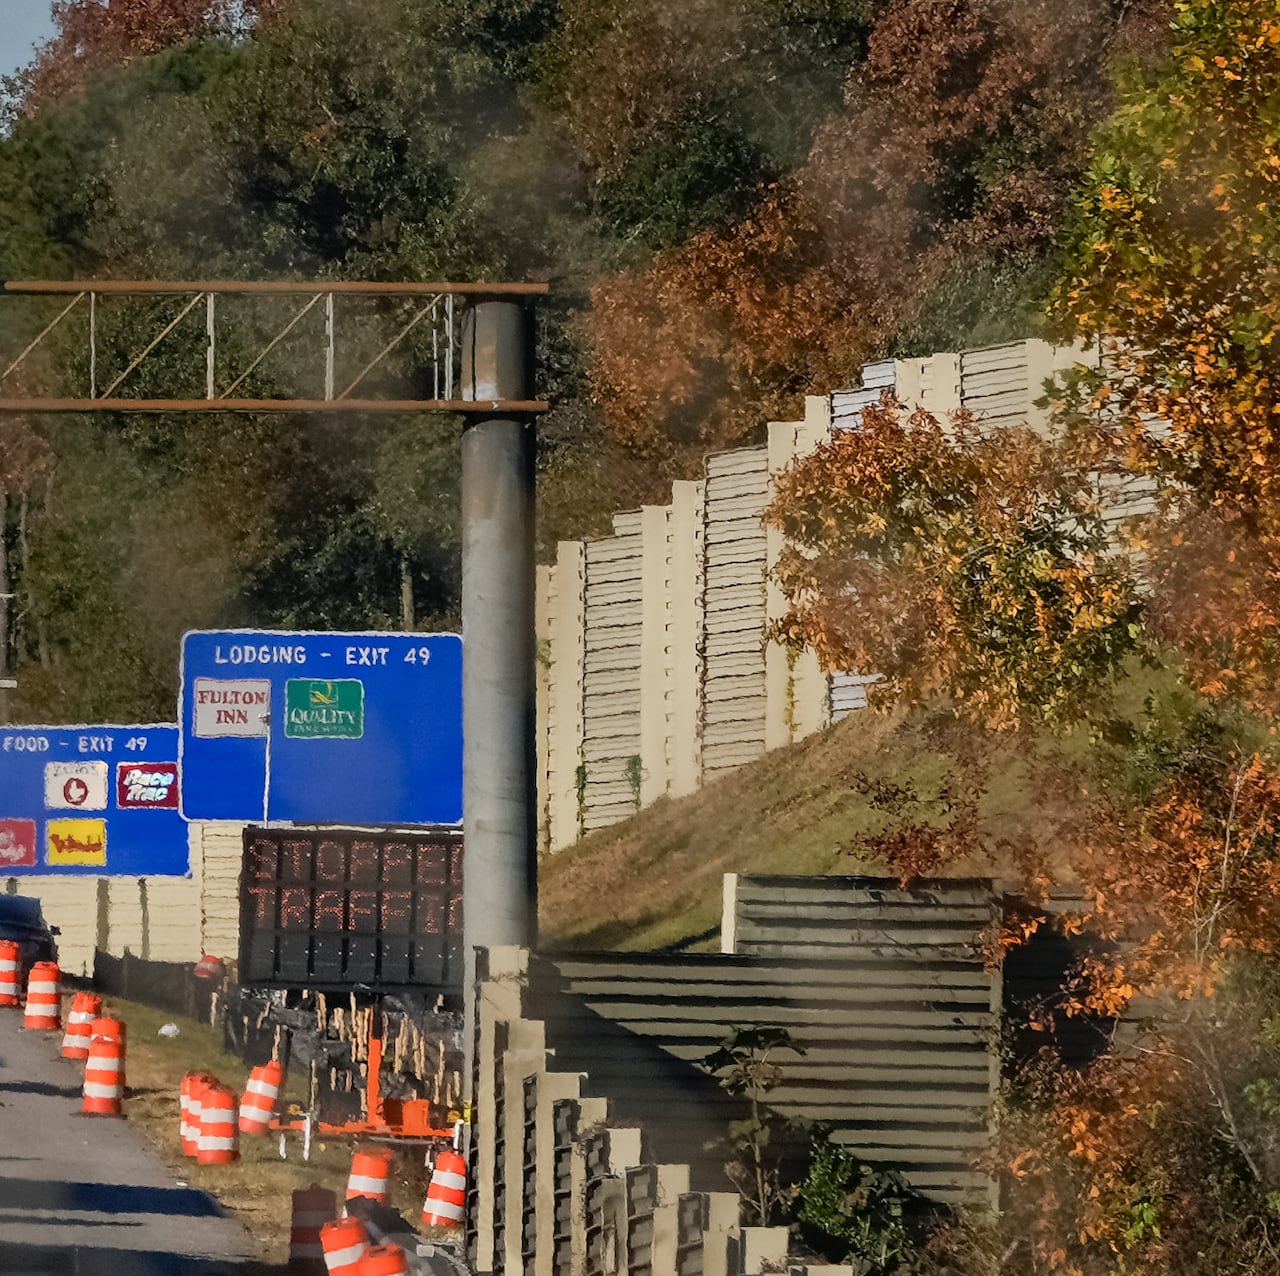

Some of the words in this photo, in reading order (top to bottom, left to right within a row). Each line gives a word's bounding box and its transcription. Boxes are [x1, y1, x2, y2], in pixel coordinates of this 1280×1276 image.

[214, 645, 307, 665] LODGING
[345, 647, 389, 666] EXIT
[403, 647, 431, 666] 49
[197, 689, 268, 705] FULTON
[215, 708, 249, 724] INN
[290, 708, 357, 724] QUALITY
[2, 736, 50, 752] FOOD
[77, 736, 114, 752] EXIT
[124, 736, 148, 752] 49
